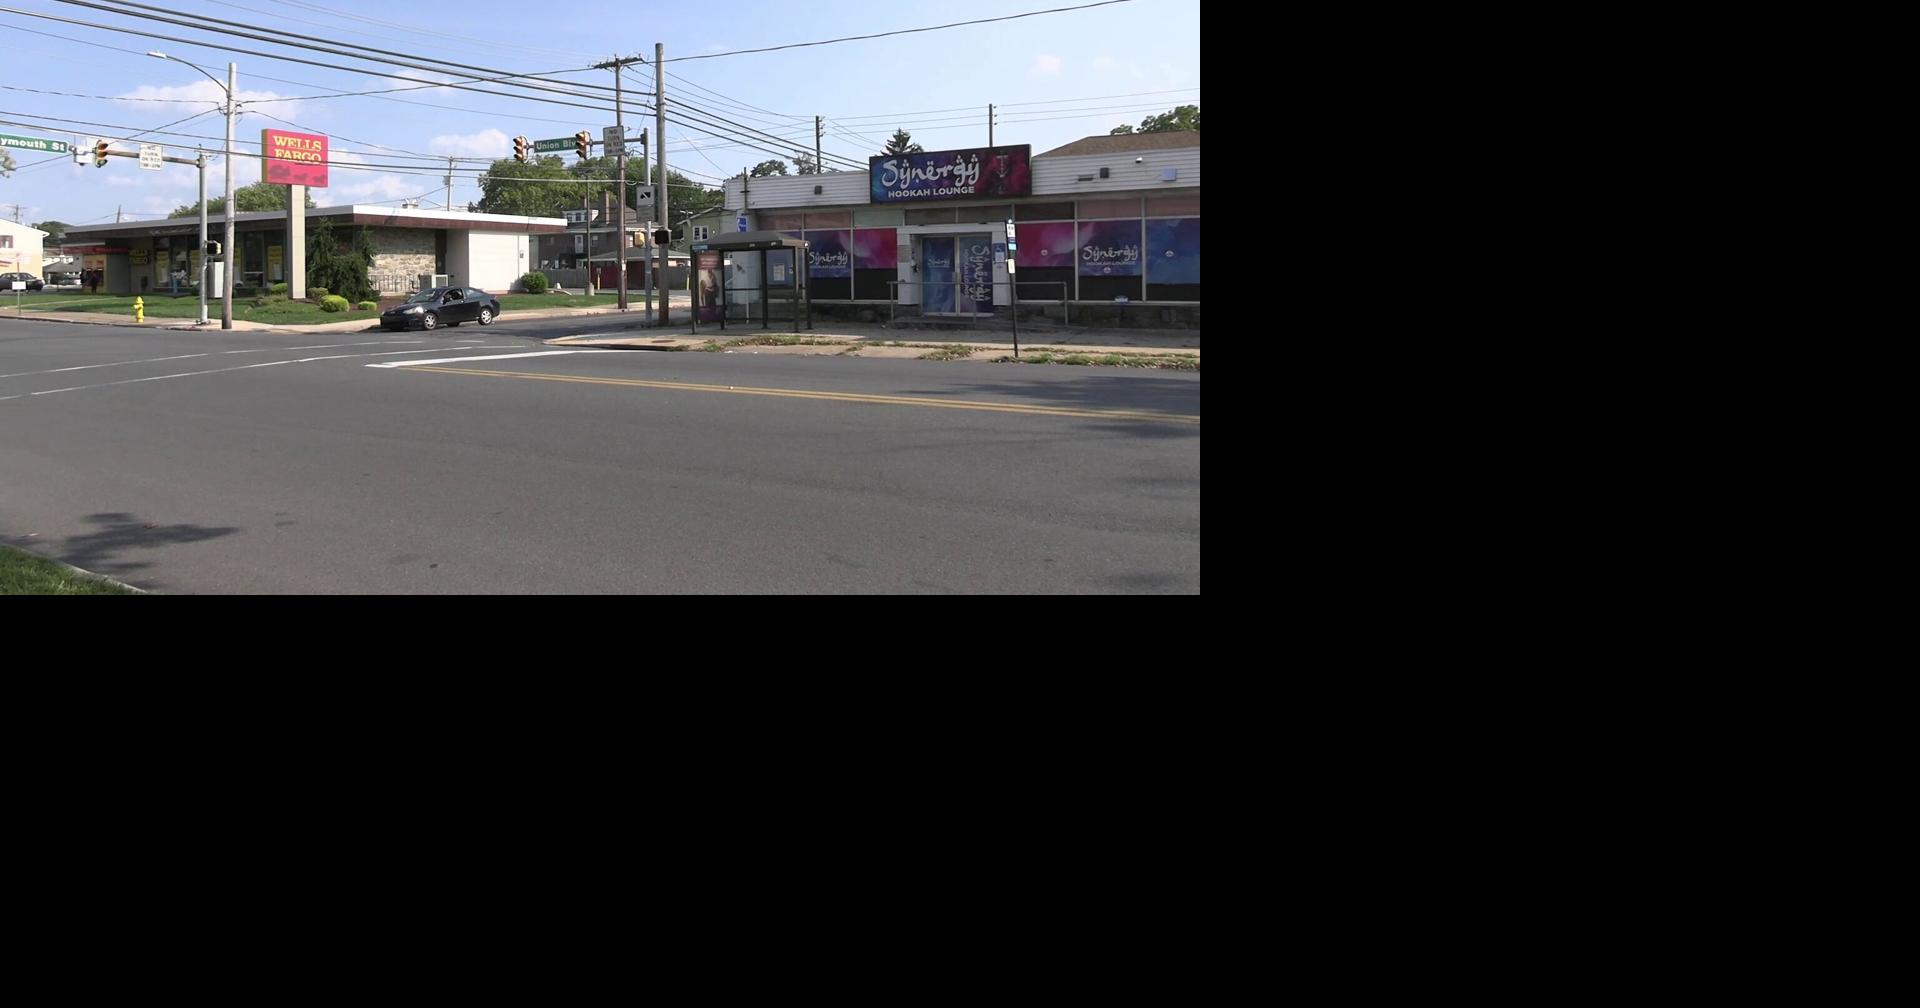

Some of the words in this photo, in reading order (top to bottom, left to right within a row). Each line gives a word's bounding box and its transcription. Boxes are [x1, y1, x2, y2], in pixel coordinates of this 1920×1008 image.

[51, 142, 65, 151] St
[273, 135, 322, 152] WELLS
[536, 142, 560, 150] Union
[563, 139, 577, 147] Blv
[274, 148, 322, 165] FARGO
[888, 188, 931, 199] HOOKAH
[933, 186, 975, 196] LOUNGE
